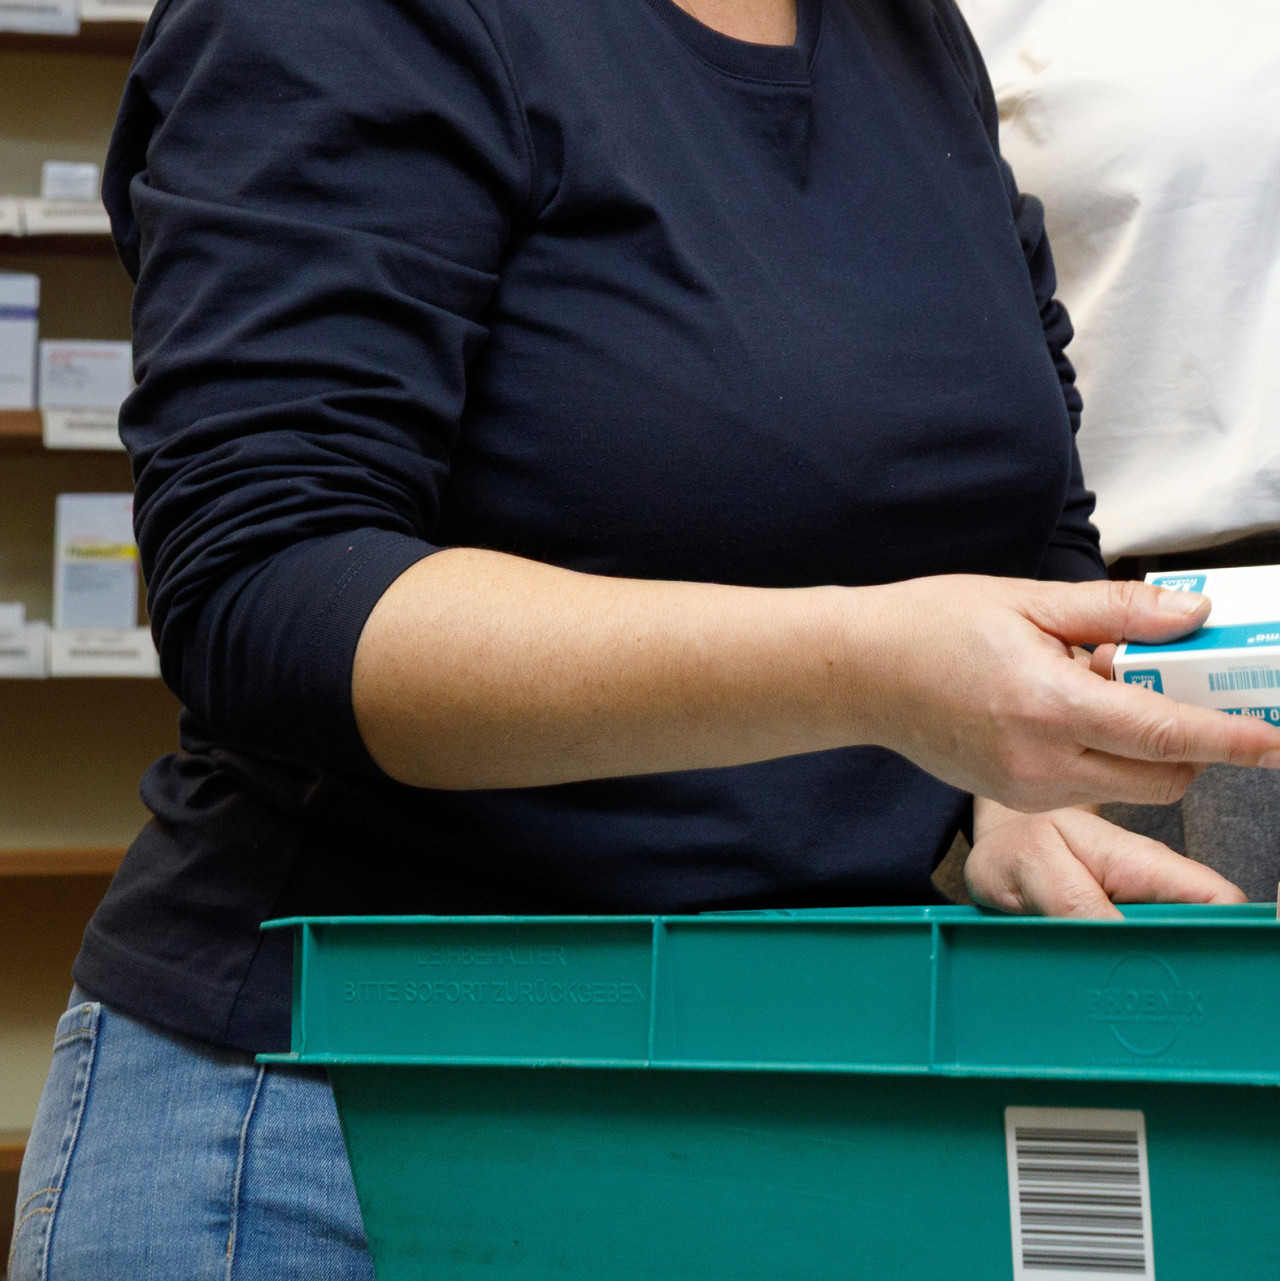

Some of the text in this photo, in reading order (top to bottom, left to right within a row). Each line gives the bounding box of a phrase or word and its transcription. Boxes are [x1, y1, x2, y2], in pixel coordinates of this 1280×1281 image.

[344, 978, 647, 1004] BITTE SOFORT ZURÜCKGEBEN
